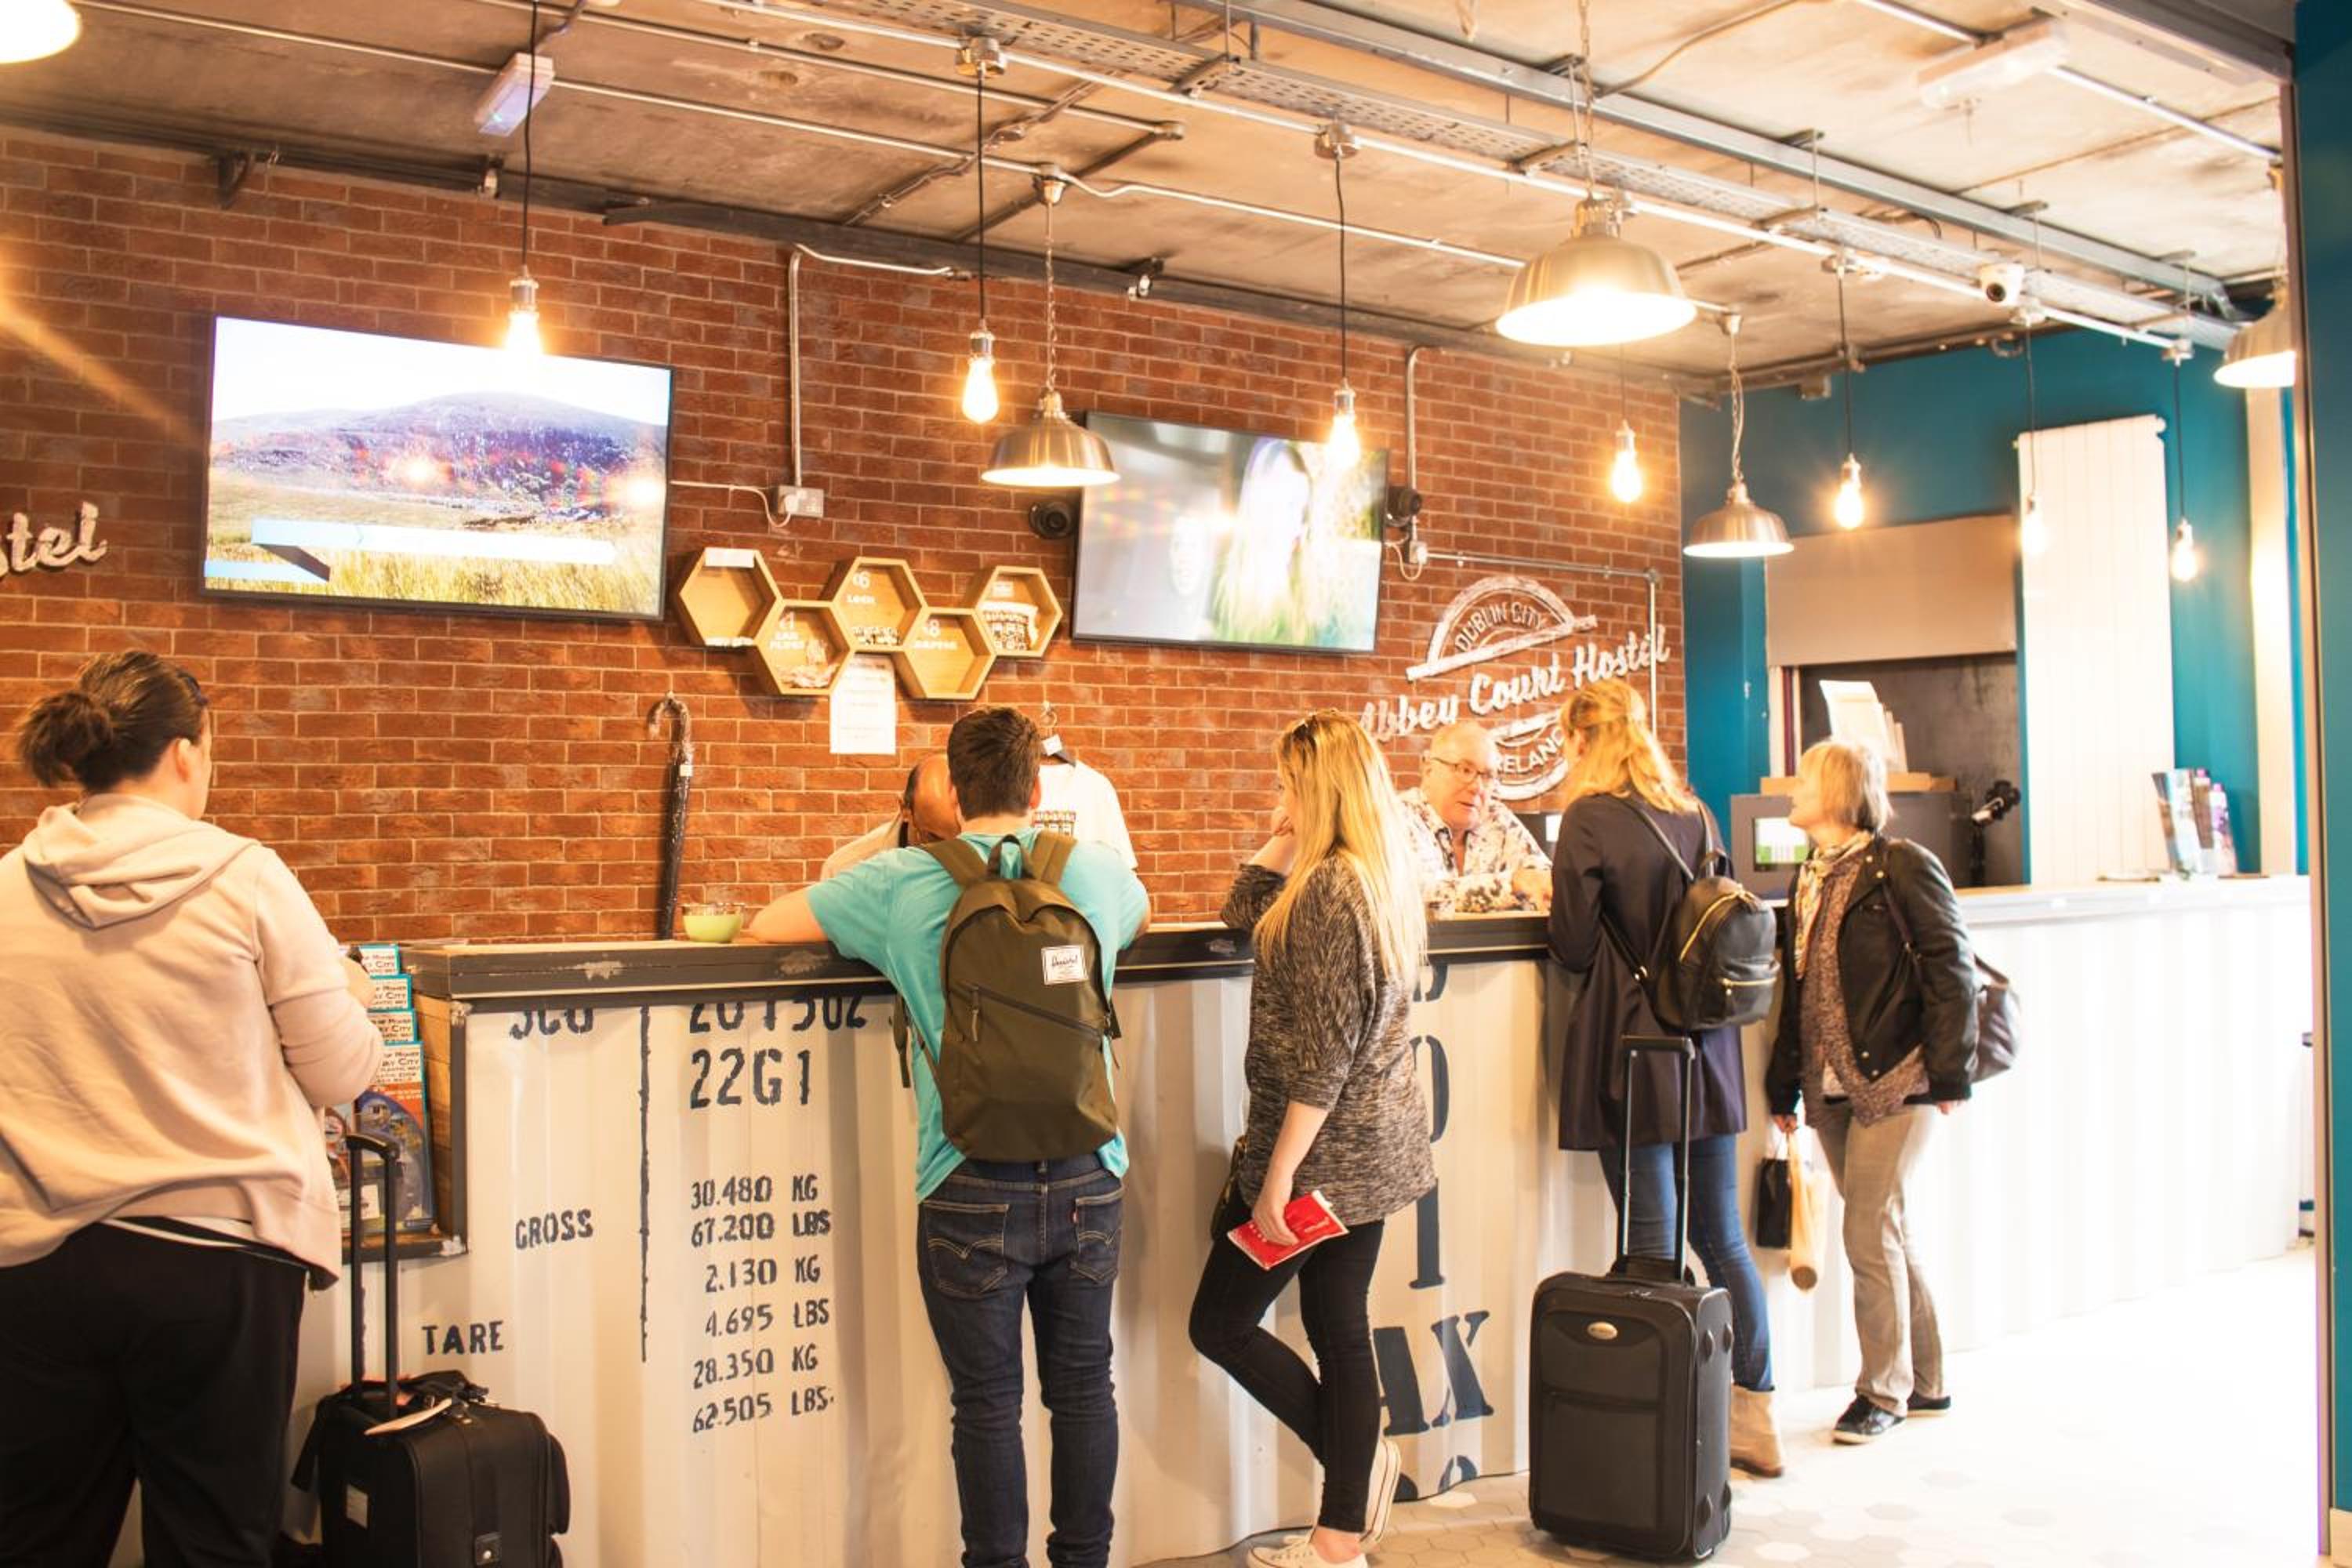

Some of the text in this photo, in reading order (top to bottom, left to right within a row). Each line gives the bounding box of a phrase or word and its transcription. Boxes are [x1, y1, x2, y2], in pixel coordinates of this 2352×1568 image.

[1454, 601, 1549, 654] DUBLIN CITY
[1468, 652, 1566, 714] Court
[1570, 624, 1671, 688] Hostel
[689, 1047, 811, 1109] 22G1
[691, 1174, 818, 1210] 30.480 KG
[515, 1208, 593, 1250] GROSS
[691, 1208, 831, 1248] 67.200 LBS
[705, 1254, 822, 1294] 2.130 KG
[421, 1319, 505, 1356] TARE
[705, 1298, 830, 1338] 4.695 LBS
[693, 1342, 819, 1390] 28.350 KG
[692, 1392, 774, 1434] 62.505
